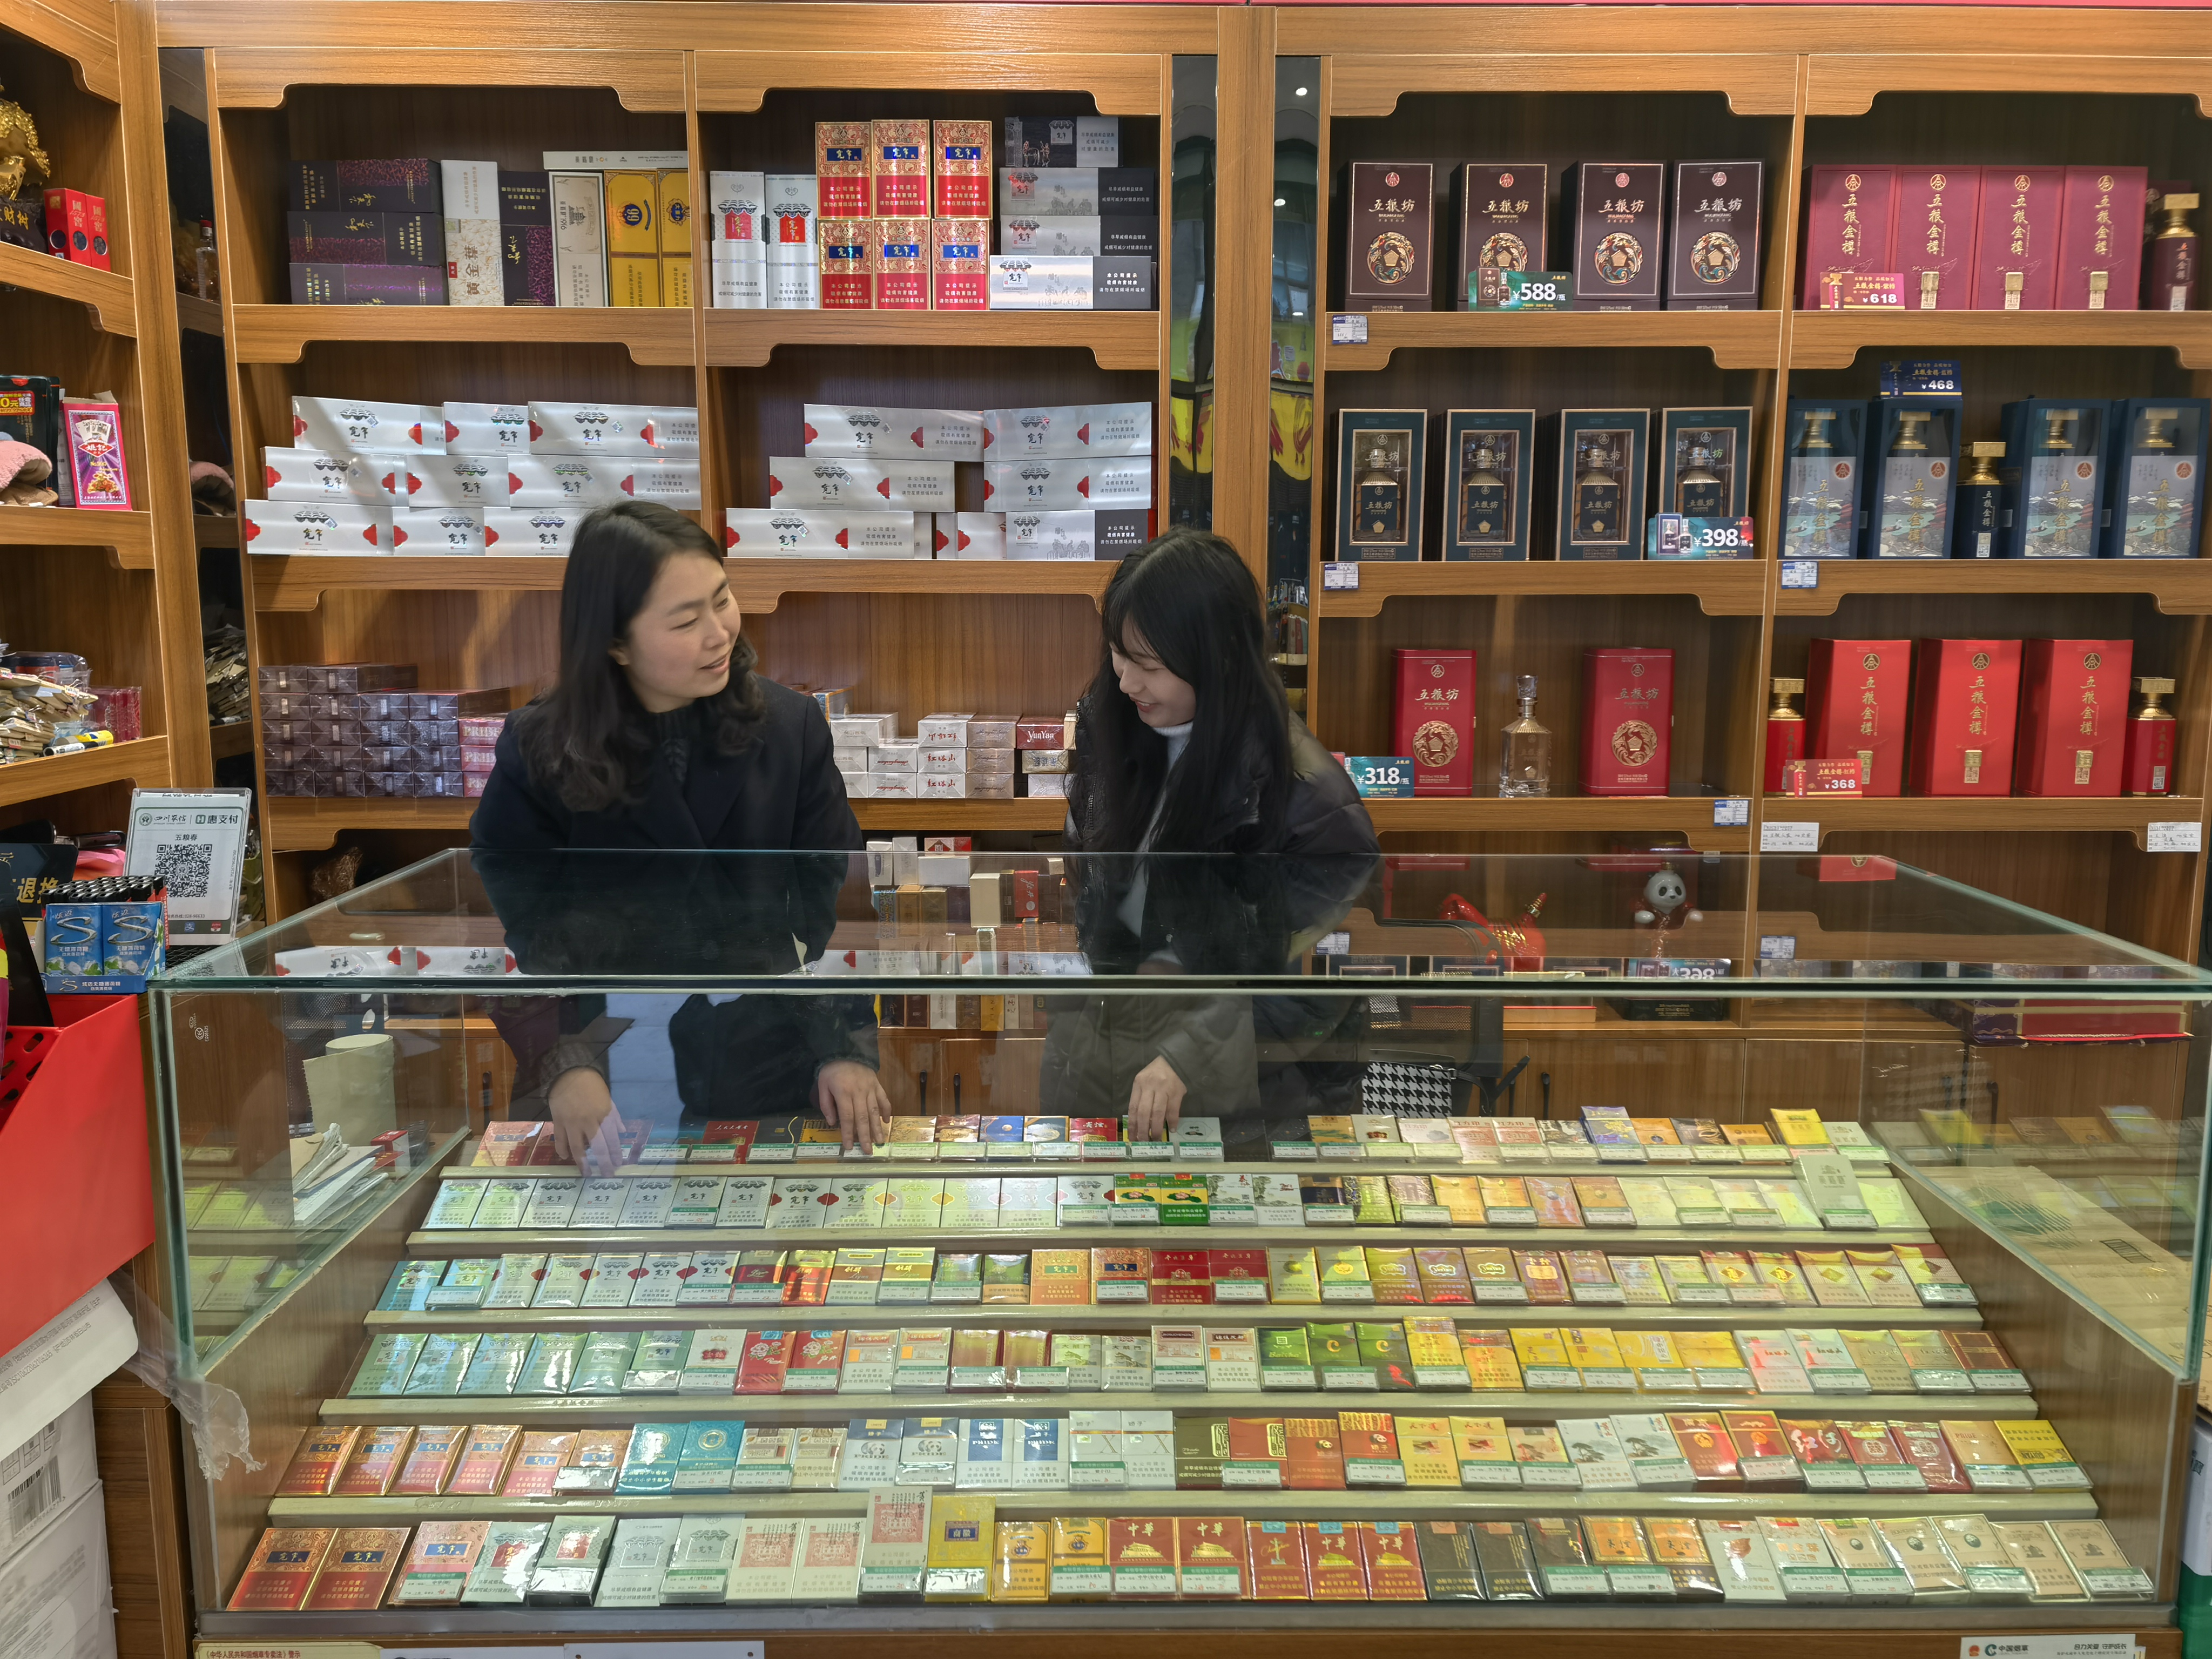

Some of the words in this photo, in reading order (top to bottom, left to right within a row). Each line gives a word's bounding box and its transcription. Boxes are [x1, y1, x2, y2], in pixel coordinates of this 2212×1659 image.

[1368, 198, 1415, 213] 五粮坊
[1482, 199, 1529, 213] 五粮坊
[1599, 199, 1645, 213] 五粮坊
[1694, 198, 1743, 213] 五粮坊
[1863, 293, 1897, 304] ¥618
[1921, 380, 1954, 389] ¥468
[1414, 687, 1460, 702] 五粮坊
[1614, 687, 1659, 701] 五粮坊
[1027, 730, 1055, 743] YunYan
[1825, 779, 1856, 789] ¥368
[207, 814, 239, 825] 惠支付
[1127, 1522, 1154, 1537] 中華
[1196, 1521, 1223, 1536] 中華
[1320, 1536, 1346, 1551] 中華
[1378, 1536, 1404, 1551] 中華
